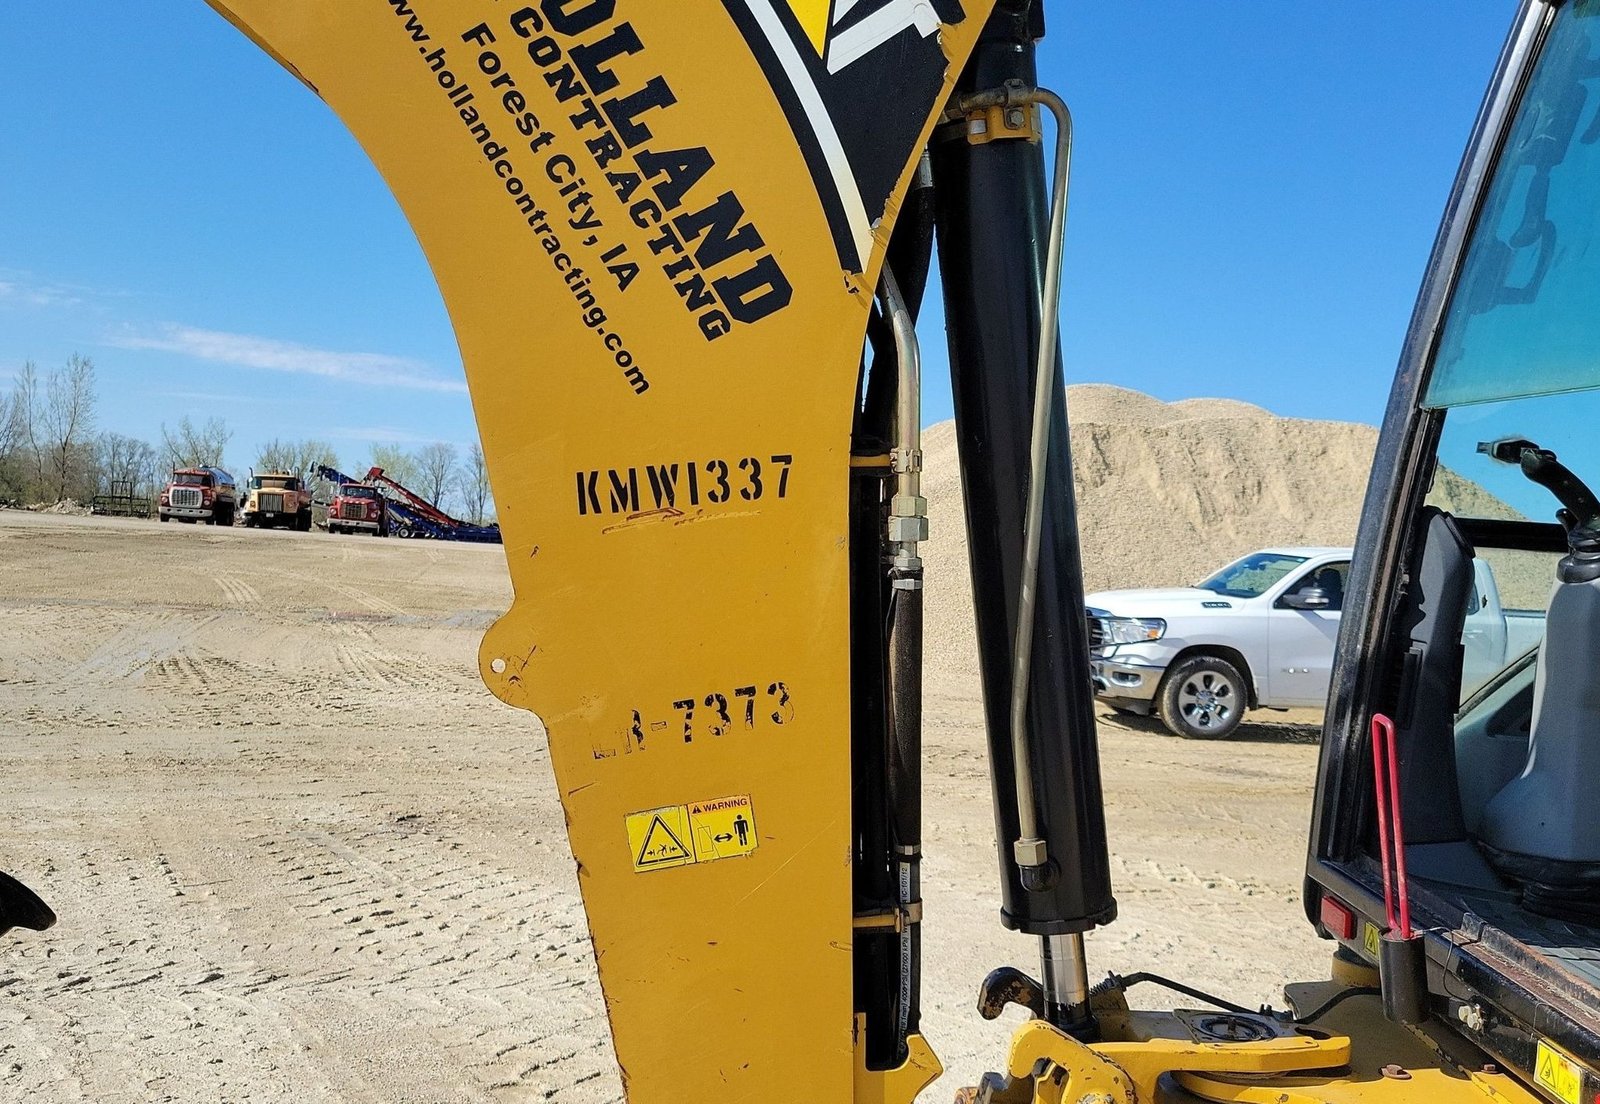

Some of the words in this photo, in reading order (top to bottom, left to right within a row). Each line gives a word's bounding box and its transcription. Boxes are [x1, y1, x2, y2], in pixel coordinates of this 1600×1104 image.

[460, 21, 556, 154] Forest
[545, 153, 603, 247] City,
[599, 243, 641, 293] IA
[509, 6, 731, 342] CONTRACTING
[703, 798, 747, 812] WARNING
